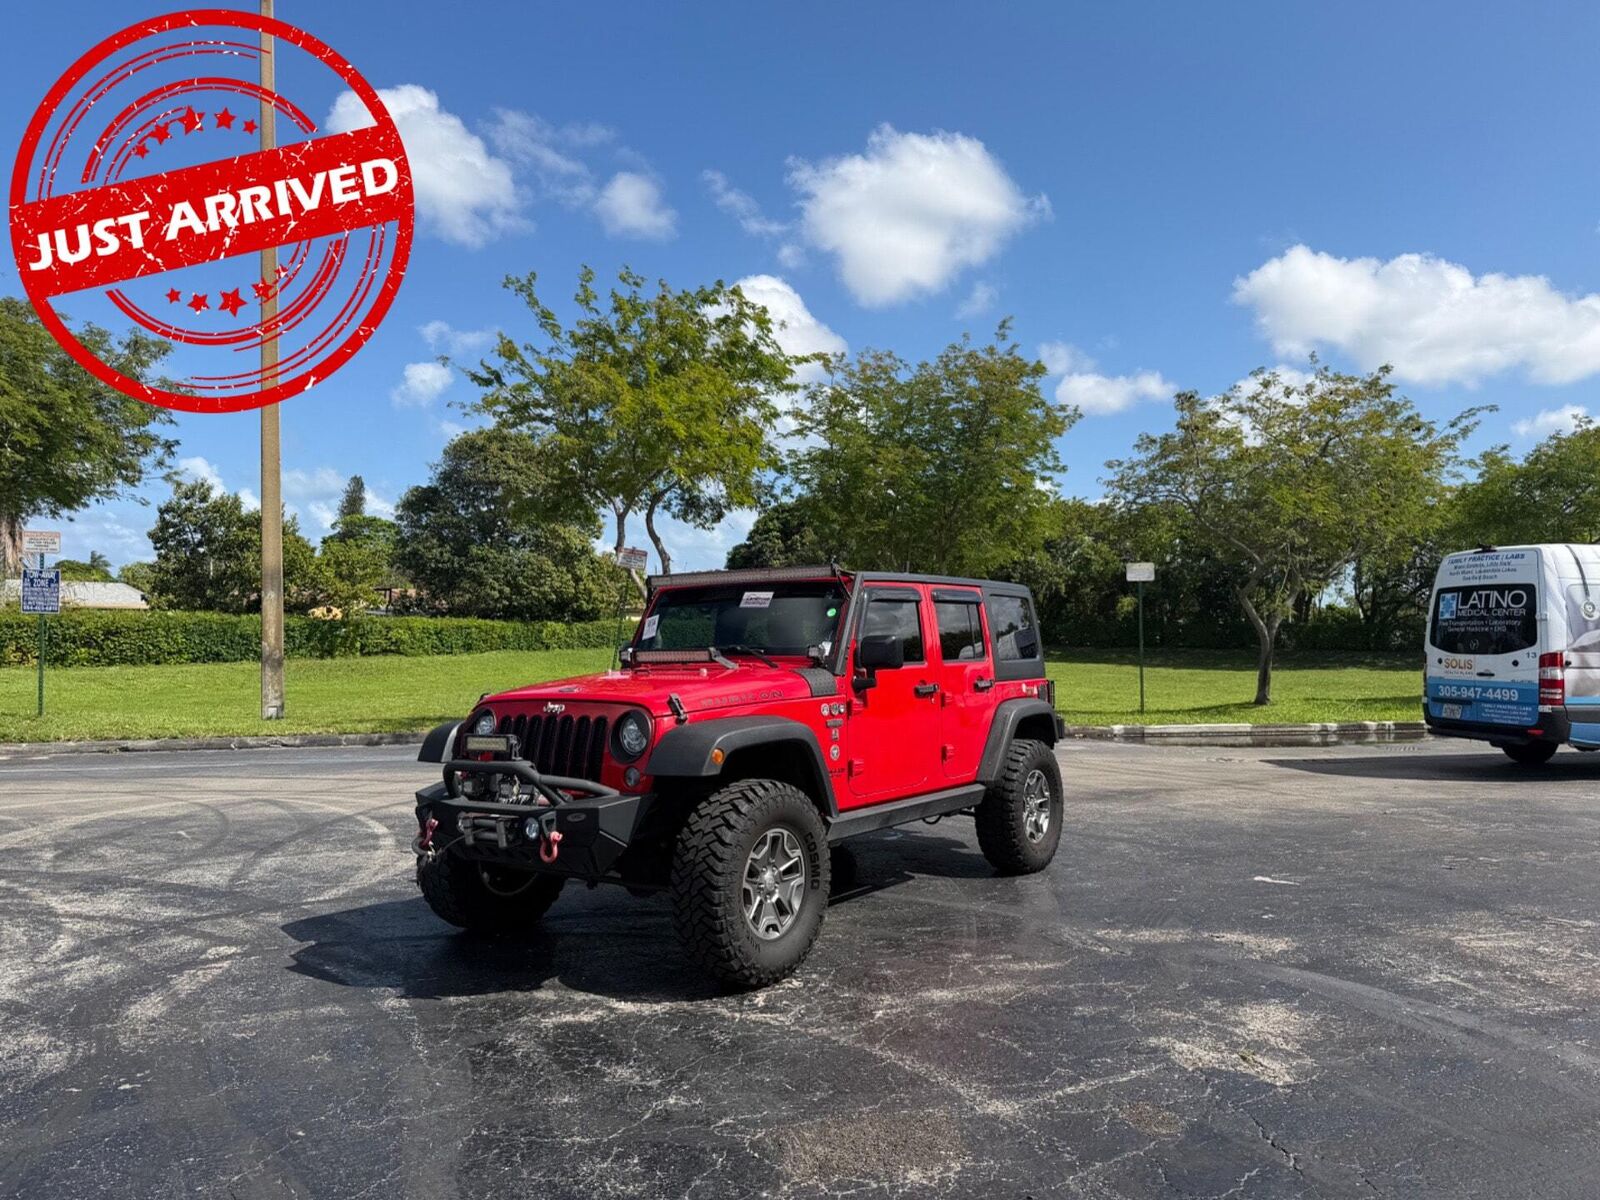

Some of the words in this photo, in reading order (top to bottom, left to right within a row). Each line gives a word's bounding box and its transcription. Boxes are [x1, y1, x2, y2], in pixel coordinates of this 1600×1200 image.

[1467, 554, 1500, 562] PRACTICE
[1458, 590, 1527, 608] LATINO
[1457, 608, 1490, 617] MEDICAL
[1491, 608, 1526, 616] CENTER
[1526, 651, 1537, 659] 13
[1444, 658, 1473, 670] SOLIS
[1438, 685, 1519, 701] 305-947-4499
[543, 701, 565, 714] Jeep
[804, 832, 820, 891] COSMO
